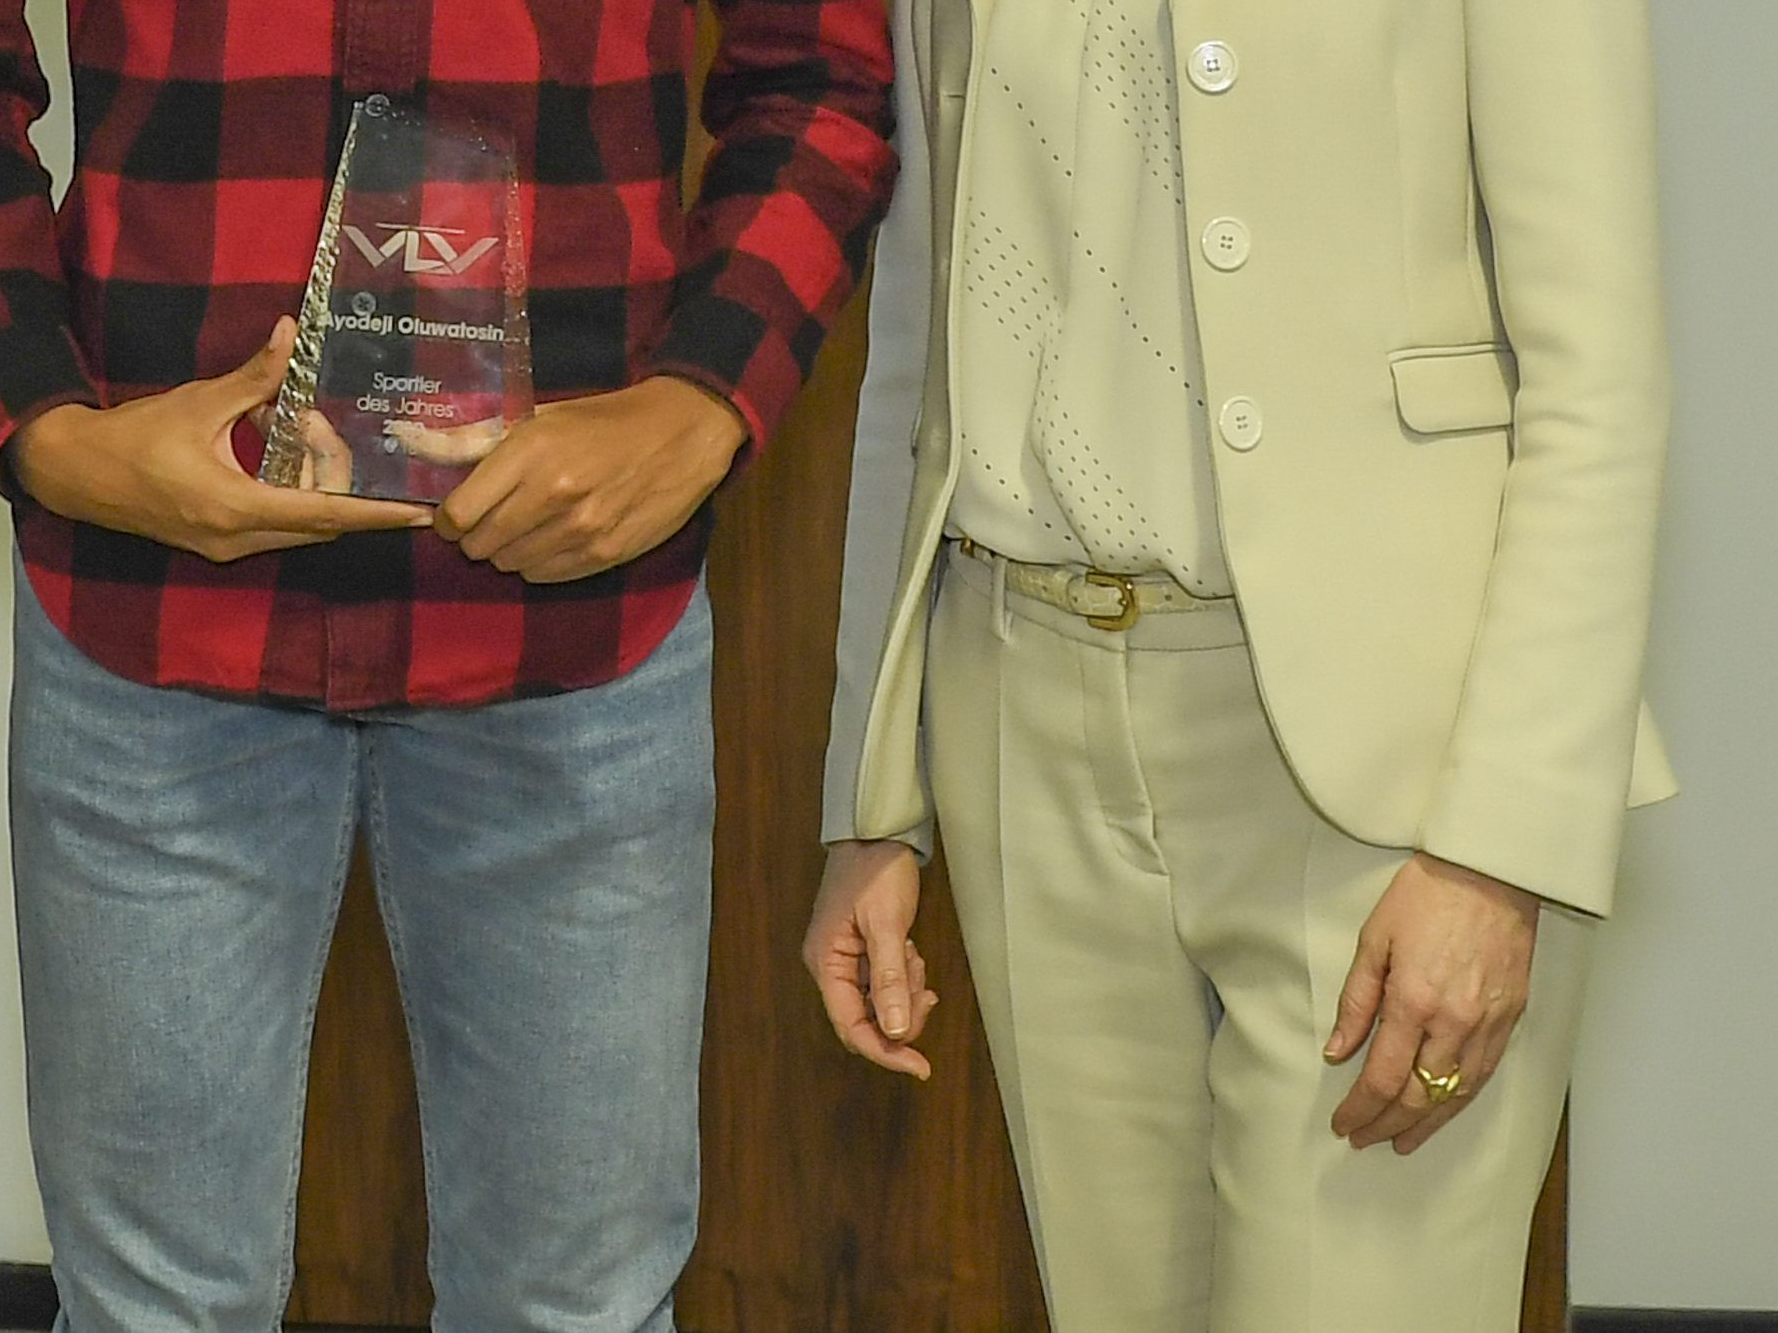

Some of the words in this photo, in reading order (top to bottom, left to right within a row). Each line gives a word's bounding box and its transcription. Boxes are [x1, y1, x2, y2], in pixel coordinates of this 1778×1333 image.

[397, 315, 505, 342] Oluwatosin
[373, 371, 442, 394] Sportler
[356, 394, 390, 412] des
[394, 397, 454, 418] Jahres
